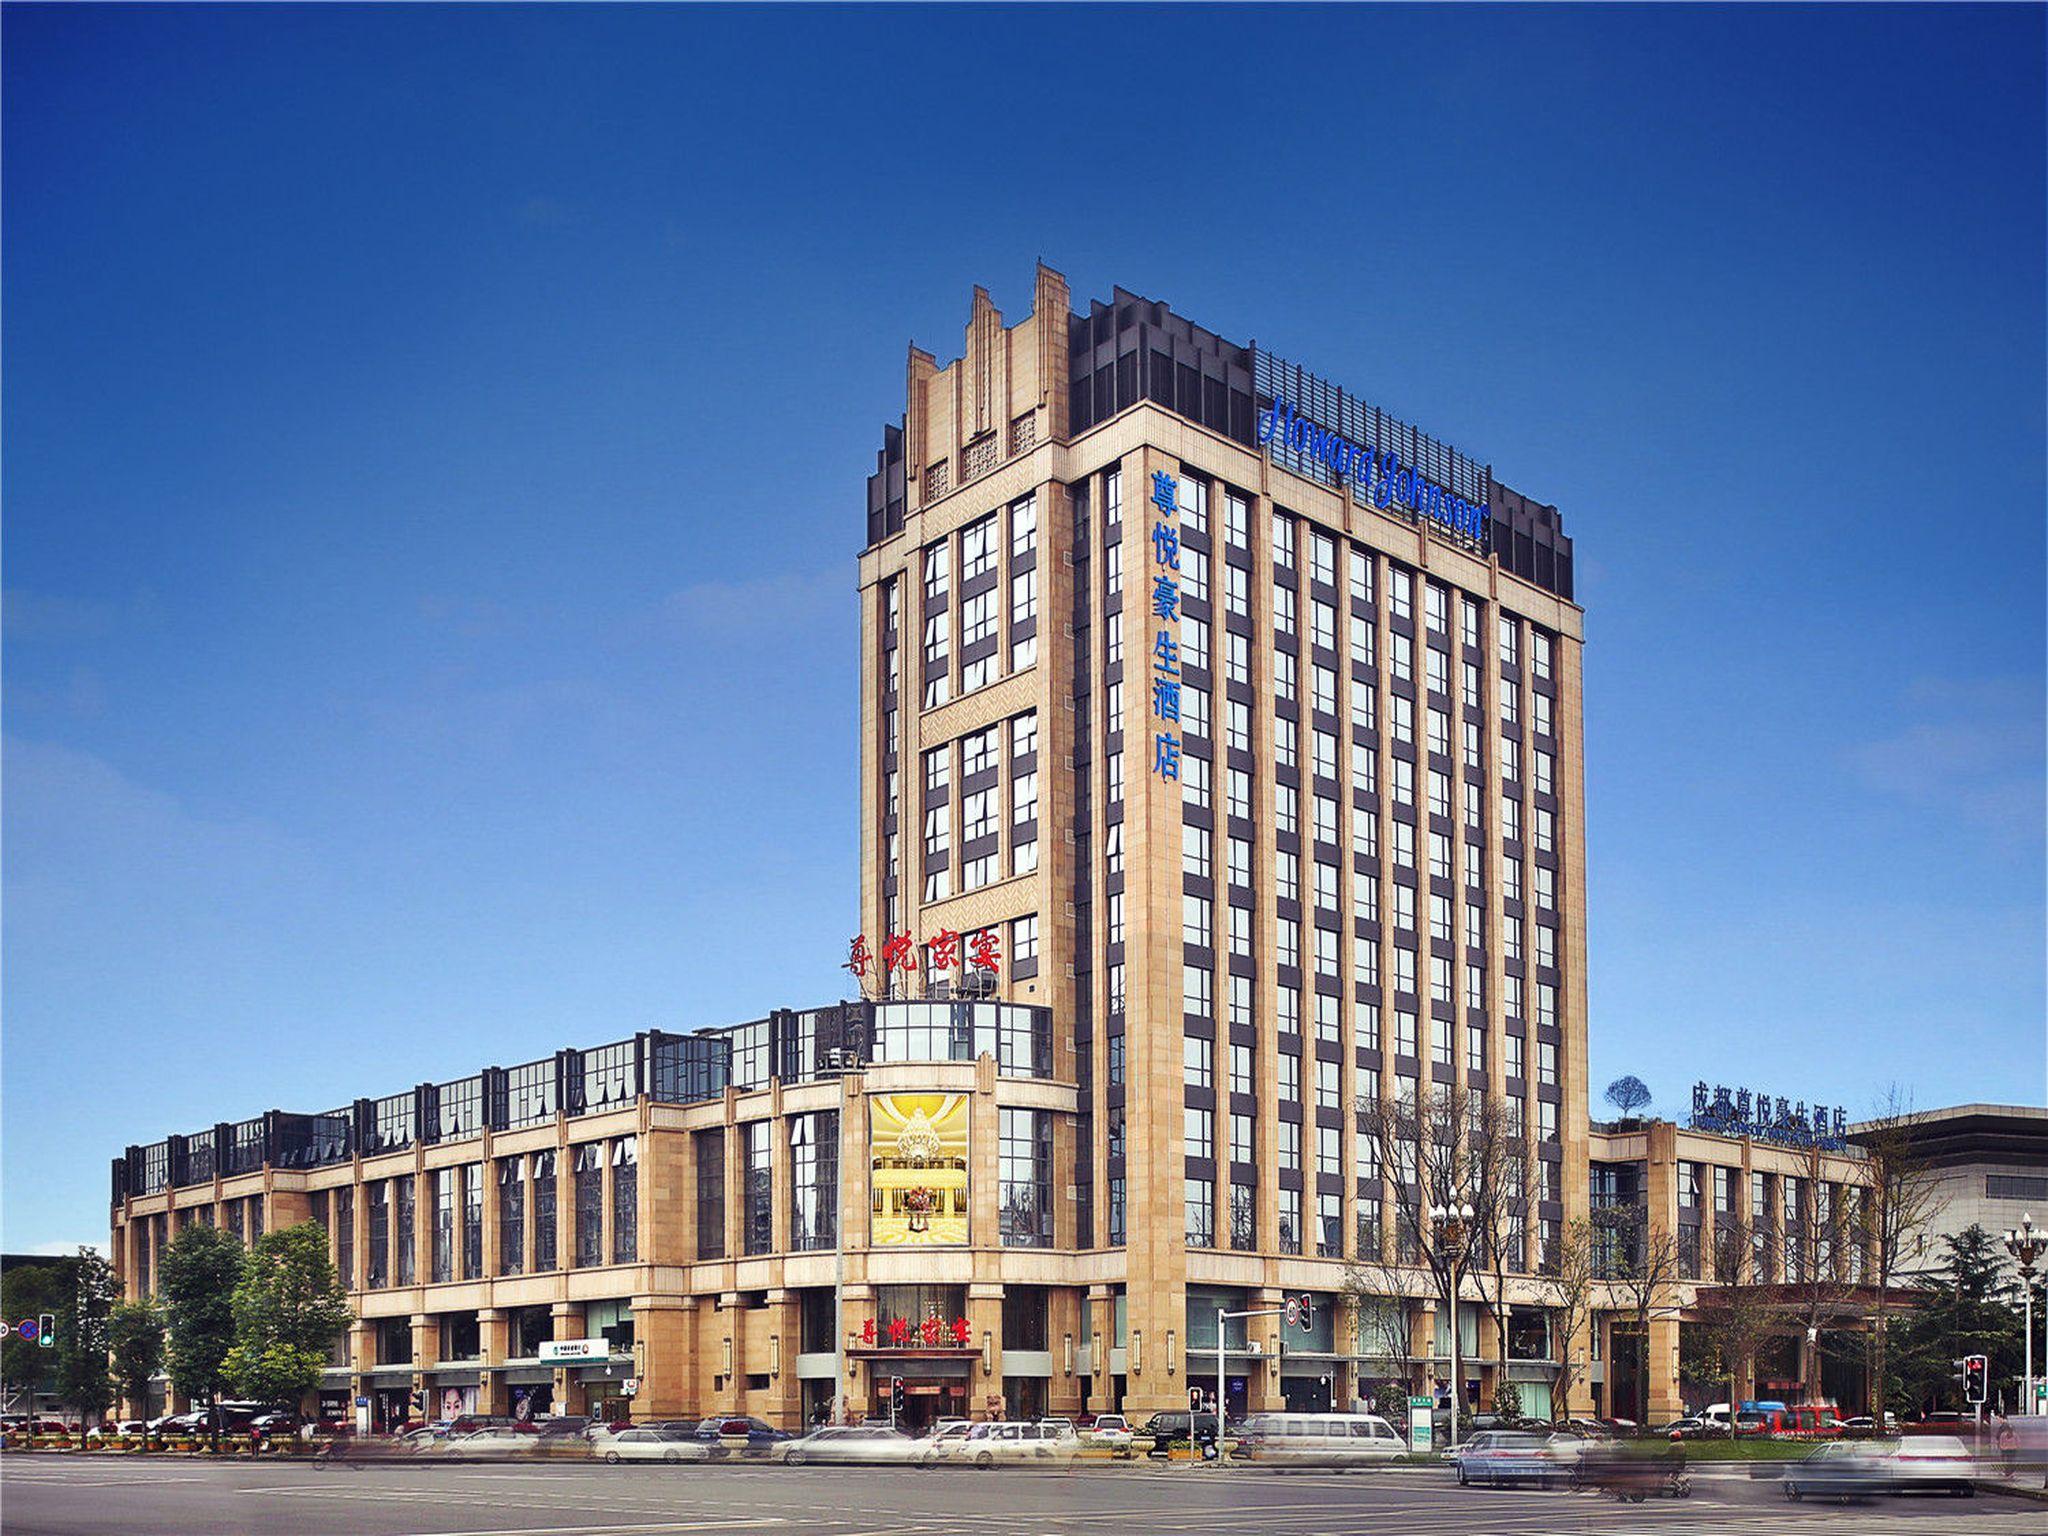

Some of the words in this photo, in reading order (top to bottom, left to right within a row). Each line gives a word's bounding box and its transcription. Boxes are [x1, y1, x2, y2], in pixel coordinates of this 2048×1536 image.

[1257, 395, 1375, 488] Howard
[1373, 450, 1490, 541] Johnson
[1150, 468, 1182, 784] 尊悦豪生酒店
[841, 927, 1003, 977] 尊悦家宴
[1691, 1080, 1848, 1138] 成都尊悦豪生酒店
[857, 1316, 972, 1345] 尊悦家宴
